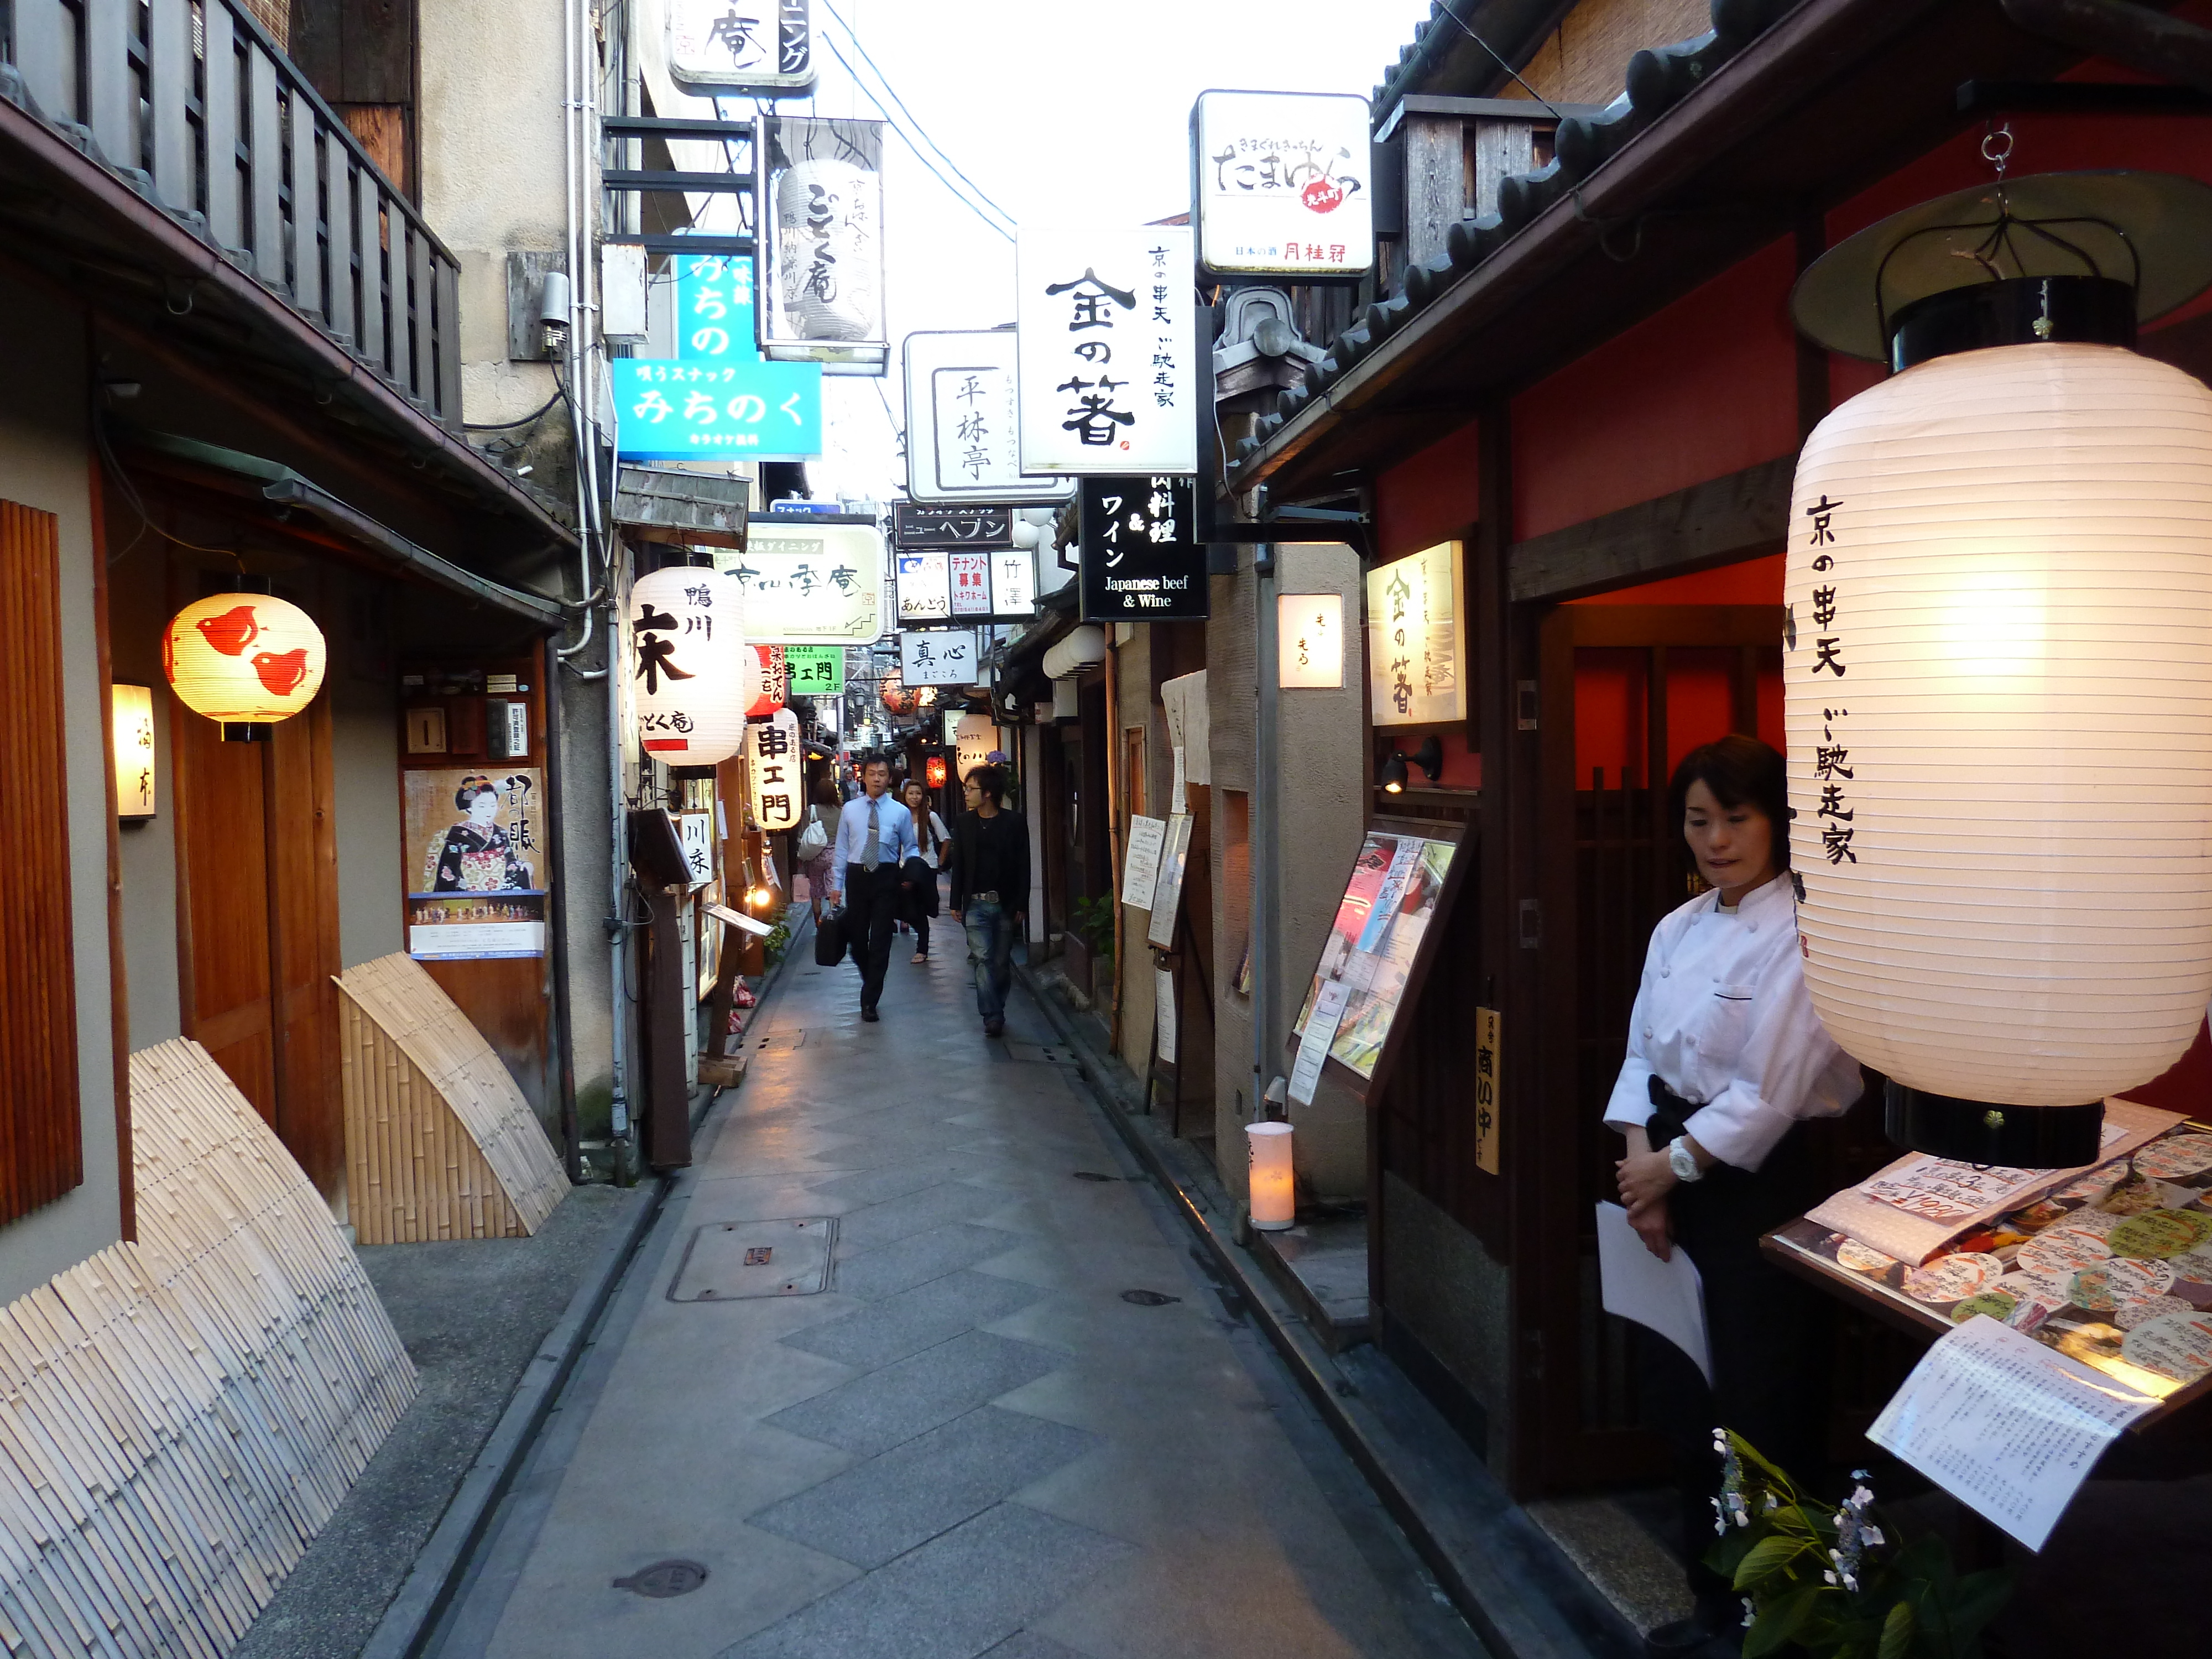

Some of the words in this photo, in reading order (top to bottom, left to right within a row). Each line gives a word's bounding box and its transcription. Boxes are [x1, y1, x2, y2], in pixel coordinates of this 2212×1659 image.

[705, 0, 767, 69] 庵
[802, 184, 839, 304] ごとく庵
[1236, 247, 1276, 256] 日本の酒
[1284, 242, 1345, 263] 月桂冠
[1147, 246, 1172, 324] 京の串天
[636, 366, 736, 383] 唄うスナック
[1150, 337, 1176, 408] ご馳走家
[633, 389, 802, 426] みちのく
[956, 375, 991, 481] 平林亭
[903, 518, 1006, 539] ニューヘブン
[1102, 496, 1124, 568] ワイン
[1128, 513, 1145, 531] &
[952, 556, 987, 571] テナント
[958, 572, 982, 587] 募集
[953, 591, 987, 601] トキワホーム
[1004, 560, 1022, 606] 竹澤
[1105, 576, 1160, 592] Japanese
[1162, 575, 1189, 590] beef
[1123, 594, 1135, 608] &
[1138, 594, 1172, 608] Wine
[1804, 494, 1846, 677] 京の串天
[684, 583, 713, 642] 鴨川
[901, 596, 947, 612] あんどう
[911, 640, 967, 669] 真心
[923, 669, 958, 679] まごころ
[1814, 707, 1858, 867] ご馳走家
[686, 818, 710, 875] 川床
[1478, 1045, 1493, 1138] 商い中
